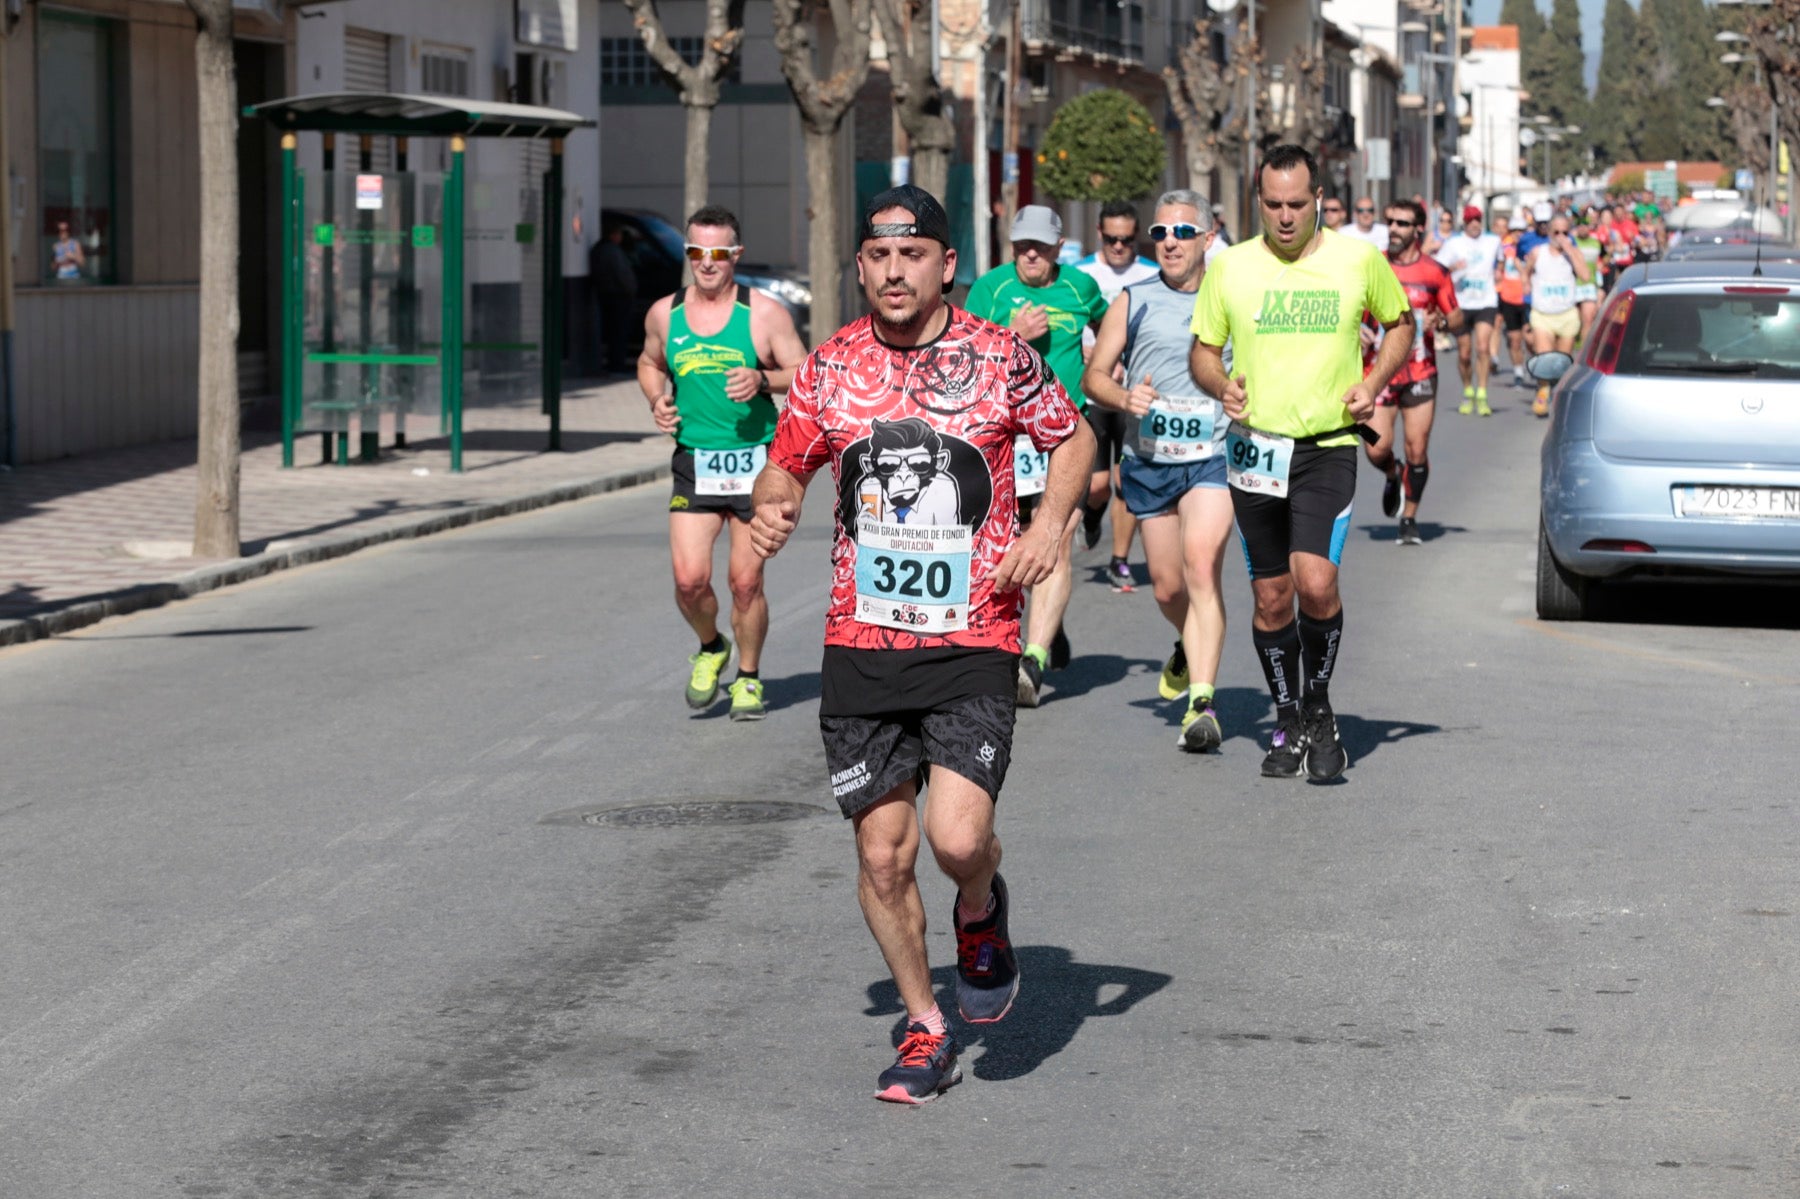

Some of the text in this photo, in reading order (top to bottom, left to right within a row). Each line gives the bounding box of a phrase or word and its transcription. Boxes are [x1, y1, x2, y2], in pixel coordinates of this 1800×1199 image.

[1261, 290, 1340, 313] IX MEMORIAL
[1290, 299, 1340, 312] PADRE
[1255, 326, 1297, 334] AGUSTINOS
[1259, 313, 1340, 326] MARCELINO
[1152, 414, 1201, 439] 898
[707, 452, 754, 473] 403
[1233, 441, 1275, 472] 991
[1703, 487, 1758, 509] 7023
[881, 526, 900, 537] GRAN
[902, 528, 929, 540] PREMIO
[931, 529, 940, 540] DE
[942, 529, 965, 539] FONDO
[890, 539, 934, 552] DIPUTACIÓN
[873, 556, 951, 598] 320
[1317, 628, 1340, 679] Kalenji
[1264, 647, 1290, 703] Kalenji
[831, 760, 867, 787] MONKEY
